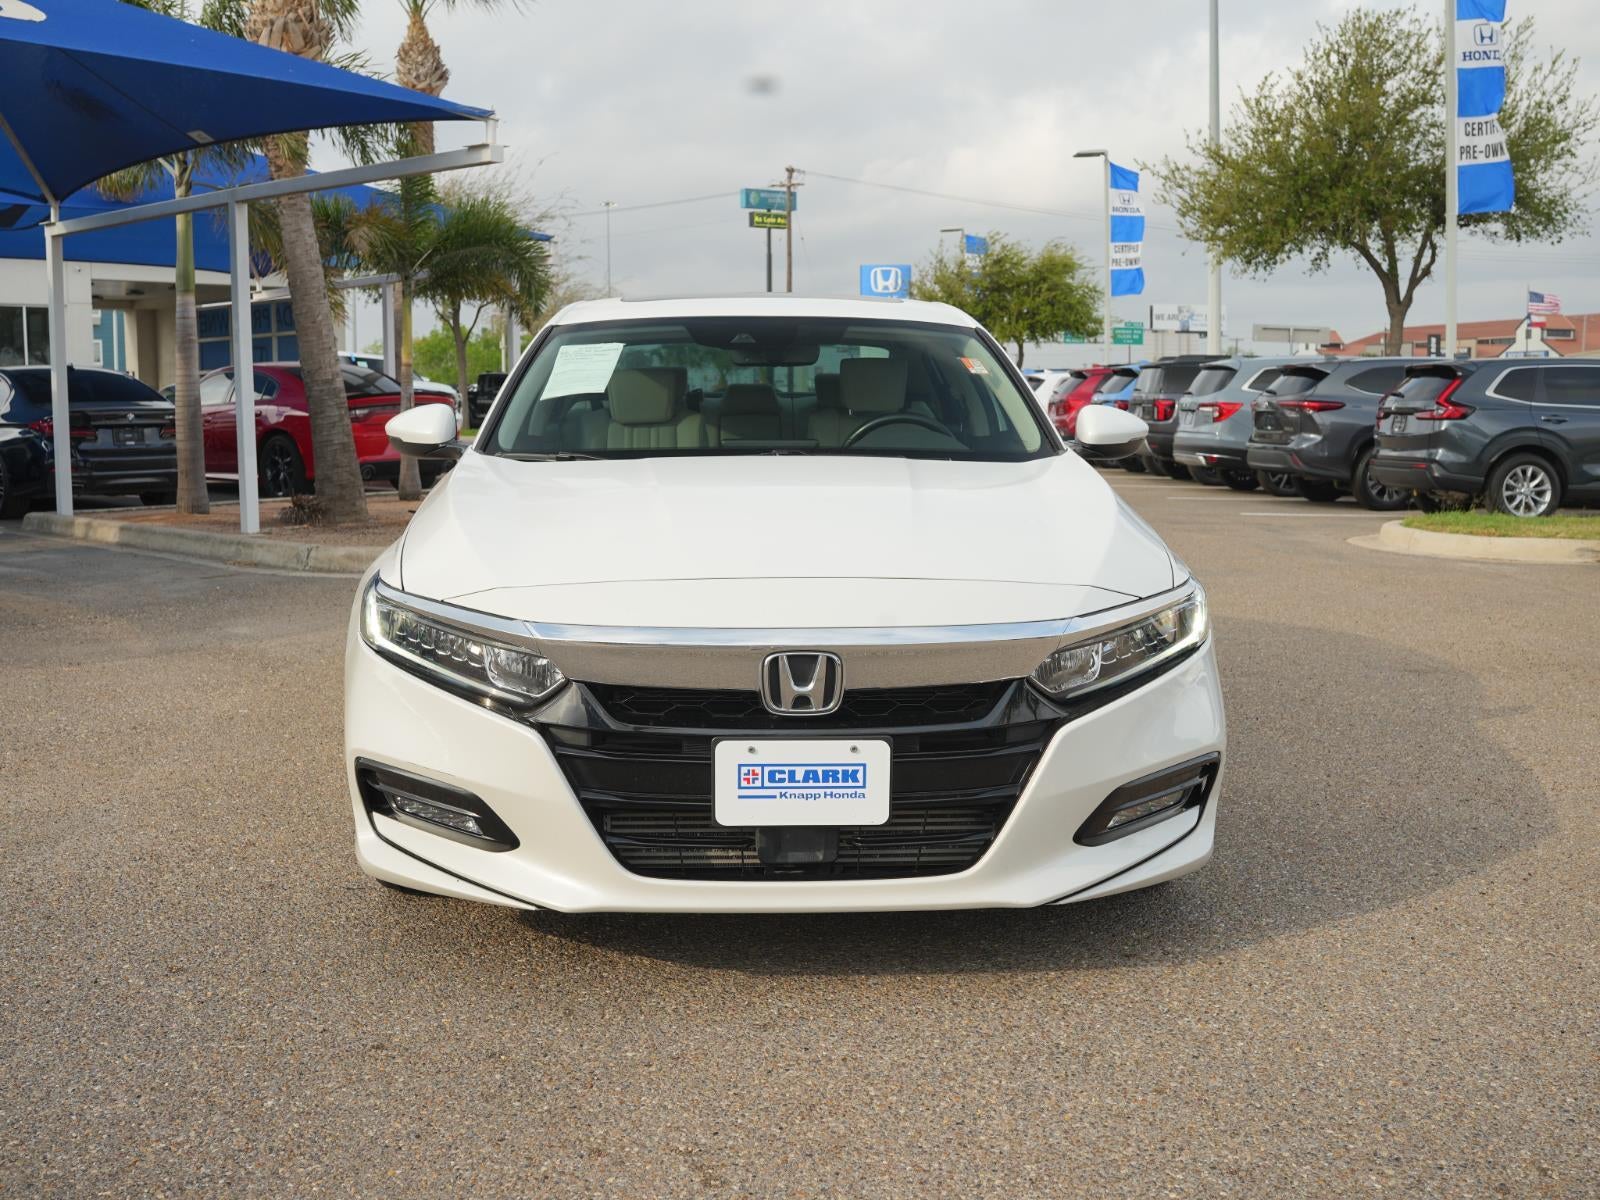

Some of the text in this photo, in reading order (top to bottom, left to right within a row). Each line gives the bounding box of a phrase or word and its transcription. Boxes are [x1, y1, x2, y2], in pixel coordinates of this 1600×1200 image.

[767, 769, 860, 784] CLARK
[779, 790, 866, 801] Knapp Honda
